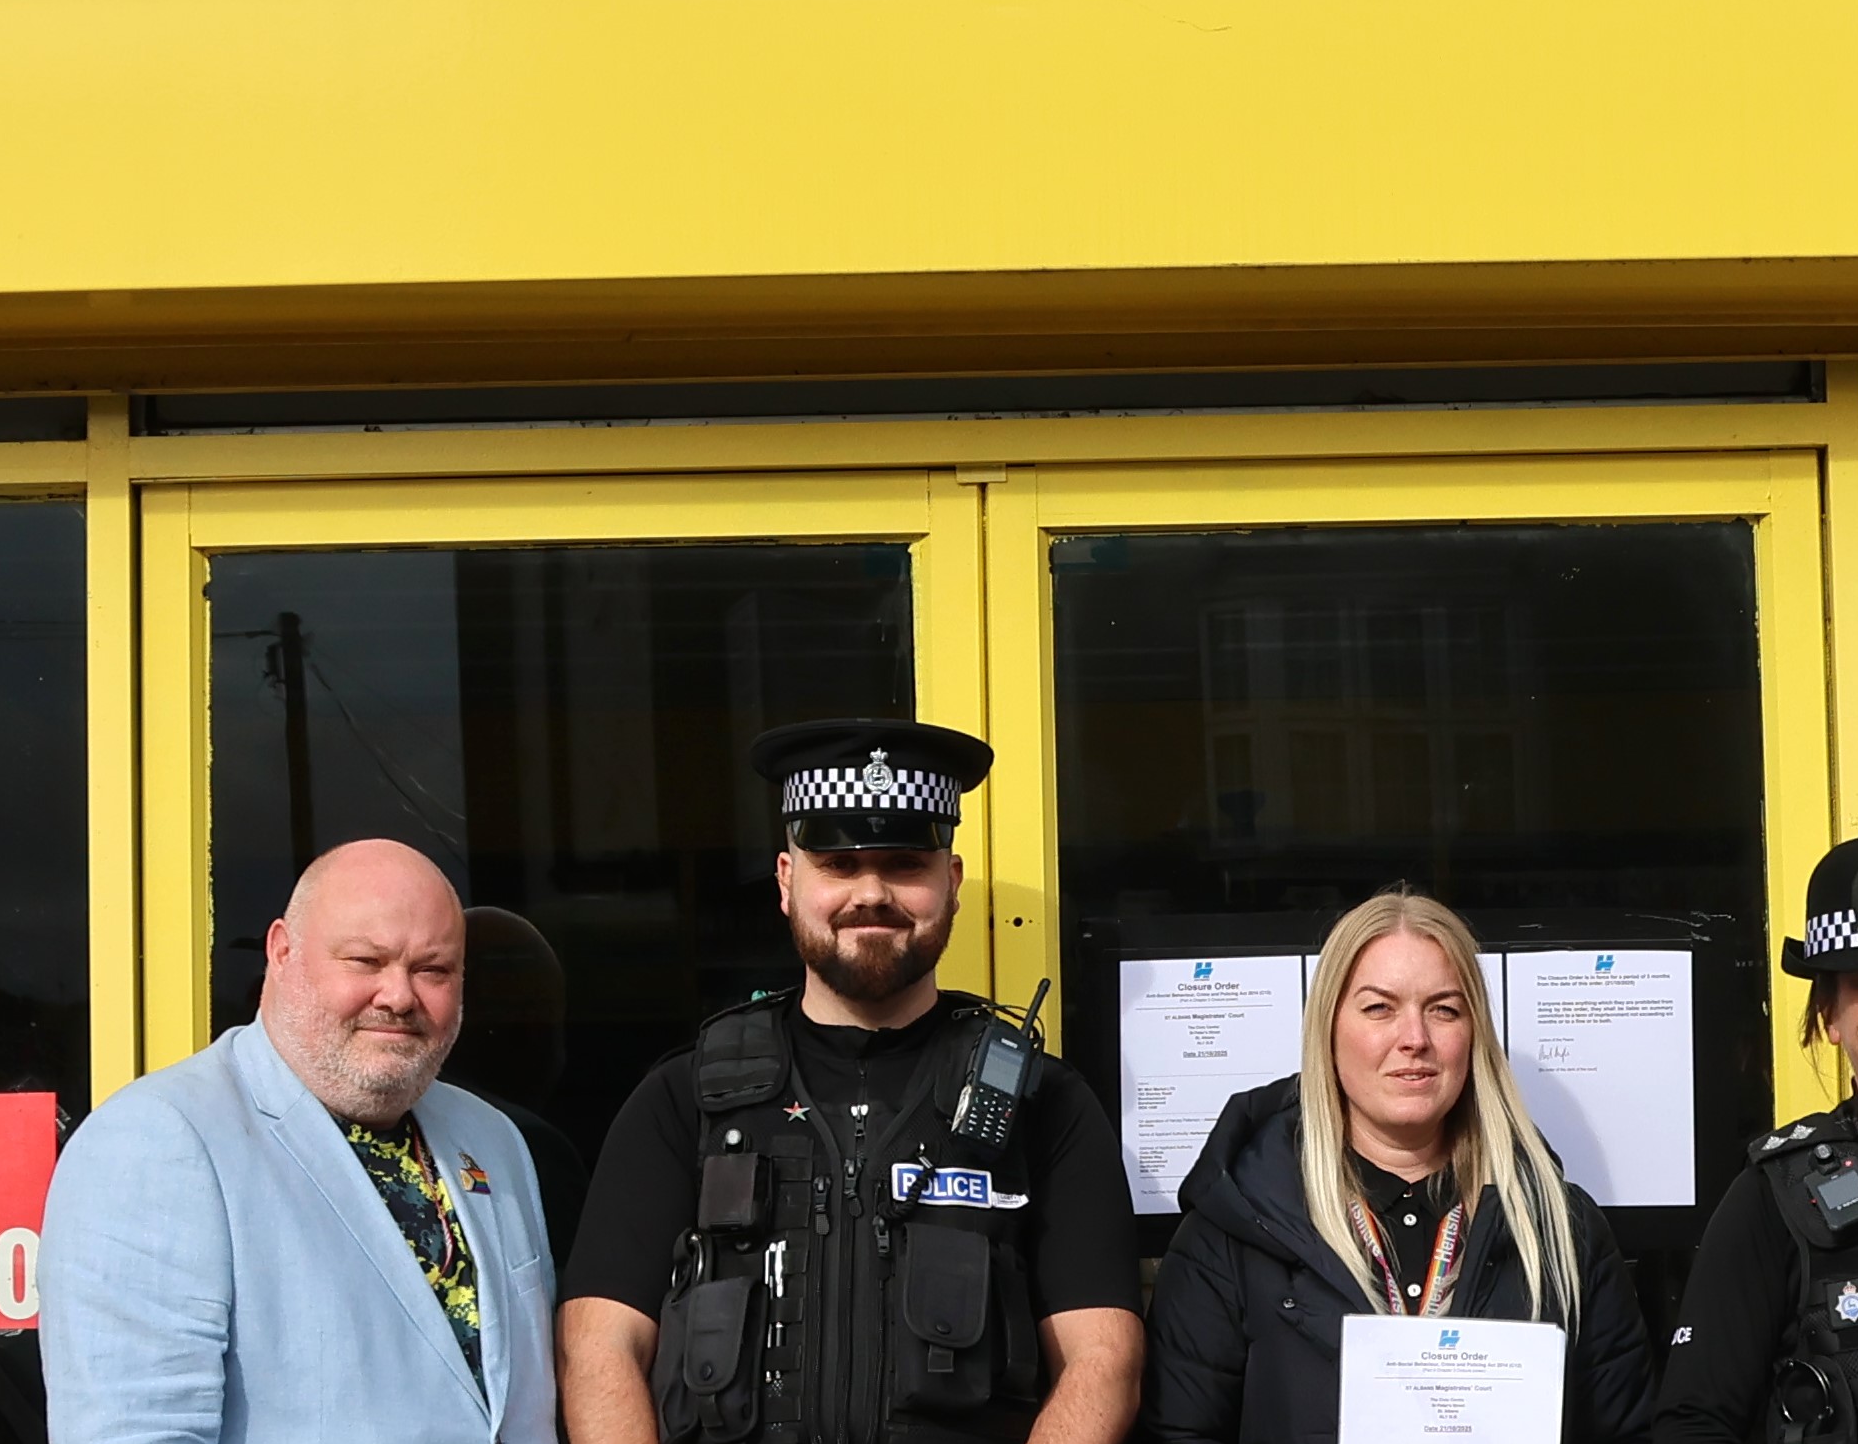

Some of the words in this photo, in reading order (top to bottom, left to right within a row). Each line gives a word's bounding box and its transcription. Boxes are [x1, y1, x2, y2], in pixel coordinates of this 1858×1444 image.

[1178, 983, 1212, 992] Closure
[1214, 982, 1240, 991] Order
[1421, 1352, 1458, 1361] Closure
[1460, 1352, 1488, 1361] Order
